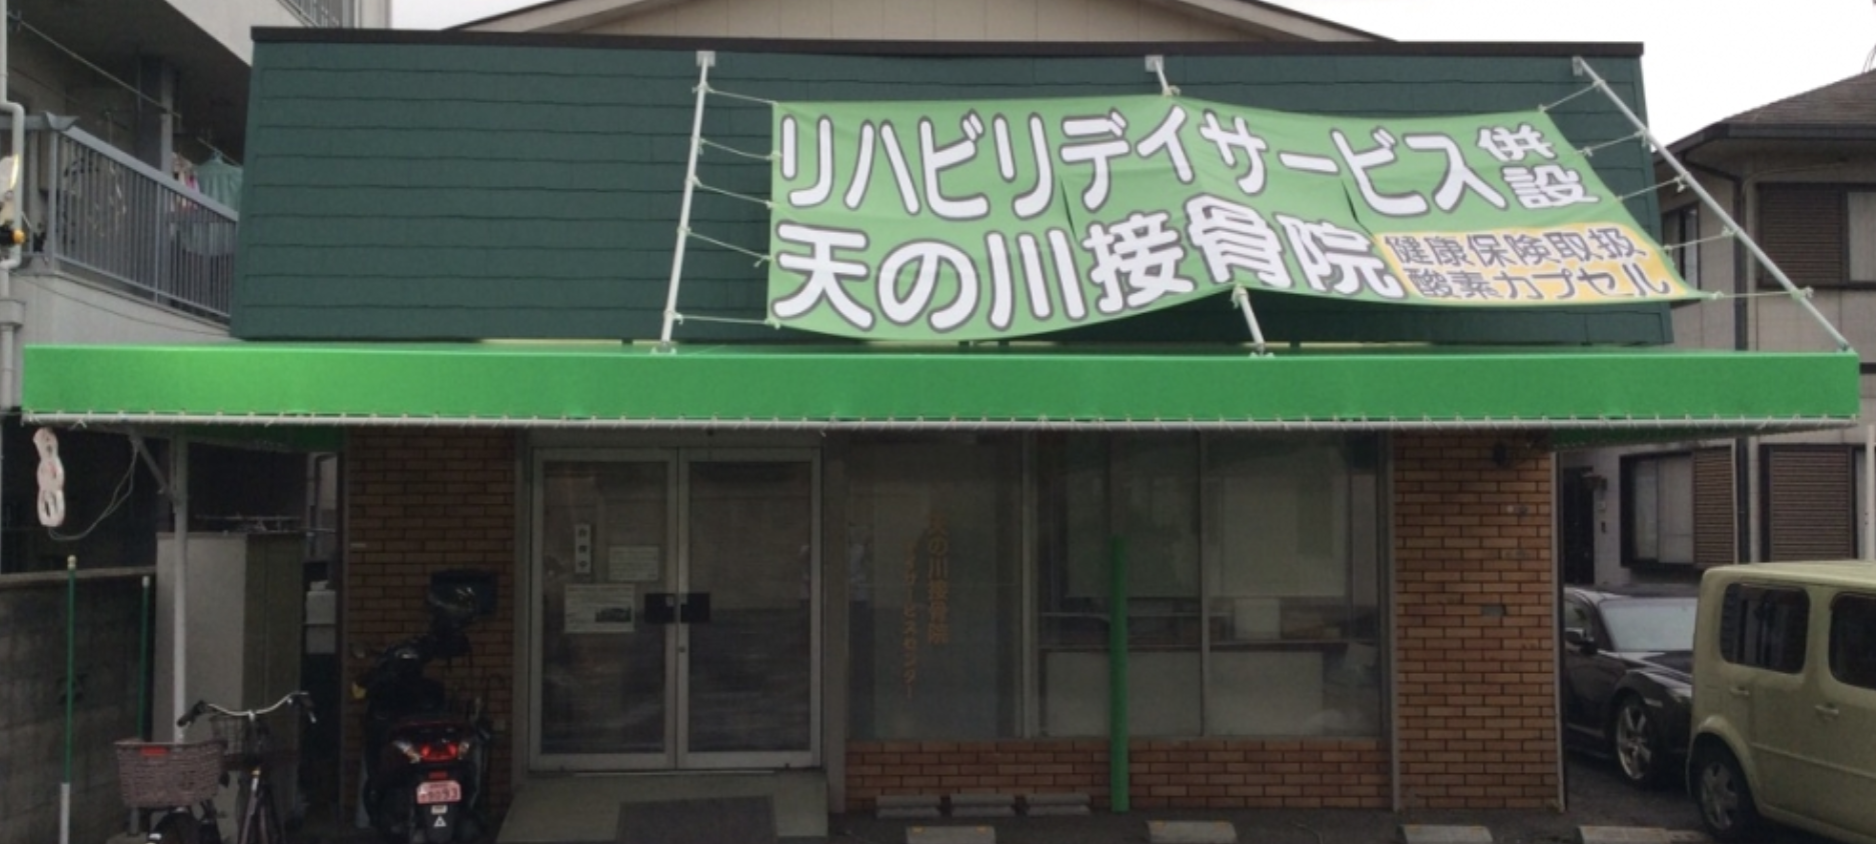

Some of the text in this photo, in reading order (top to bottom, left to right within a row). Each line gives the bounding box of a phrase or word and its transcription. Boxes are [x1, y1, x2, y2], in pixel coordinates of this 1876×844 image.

[777, 105, 1508, 218] リハビリデイサービス
[1476, 122, 1601, 210] 併設
[771, 194, 1407, 331] 天の川接骨院
[1384, 227, 1647, 268] 健康保険取扱
[1402, 263, 1670, 299] 酸素カプセル
